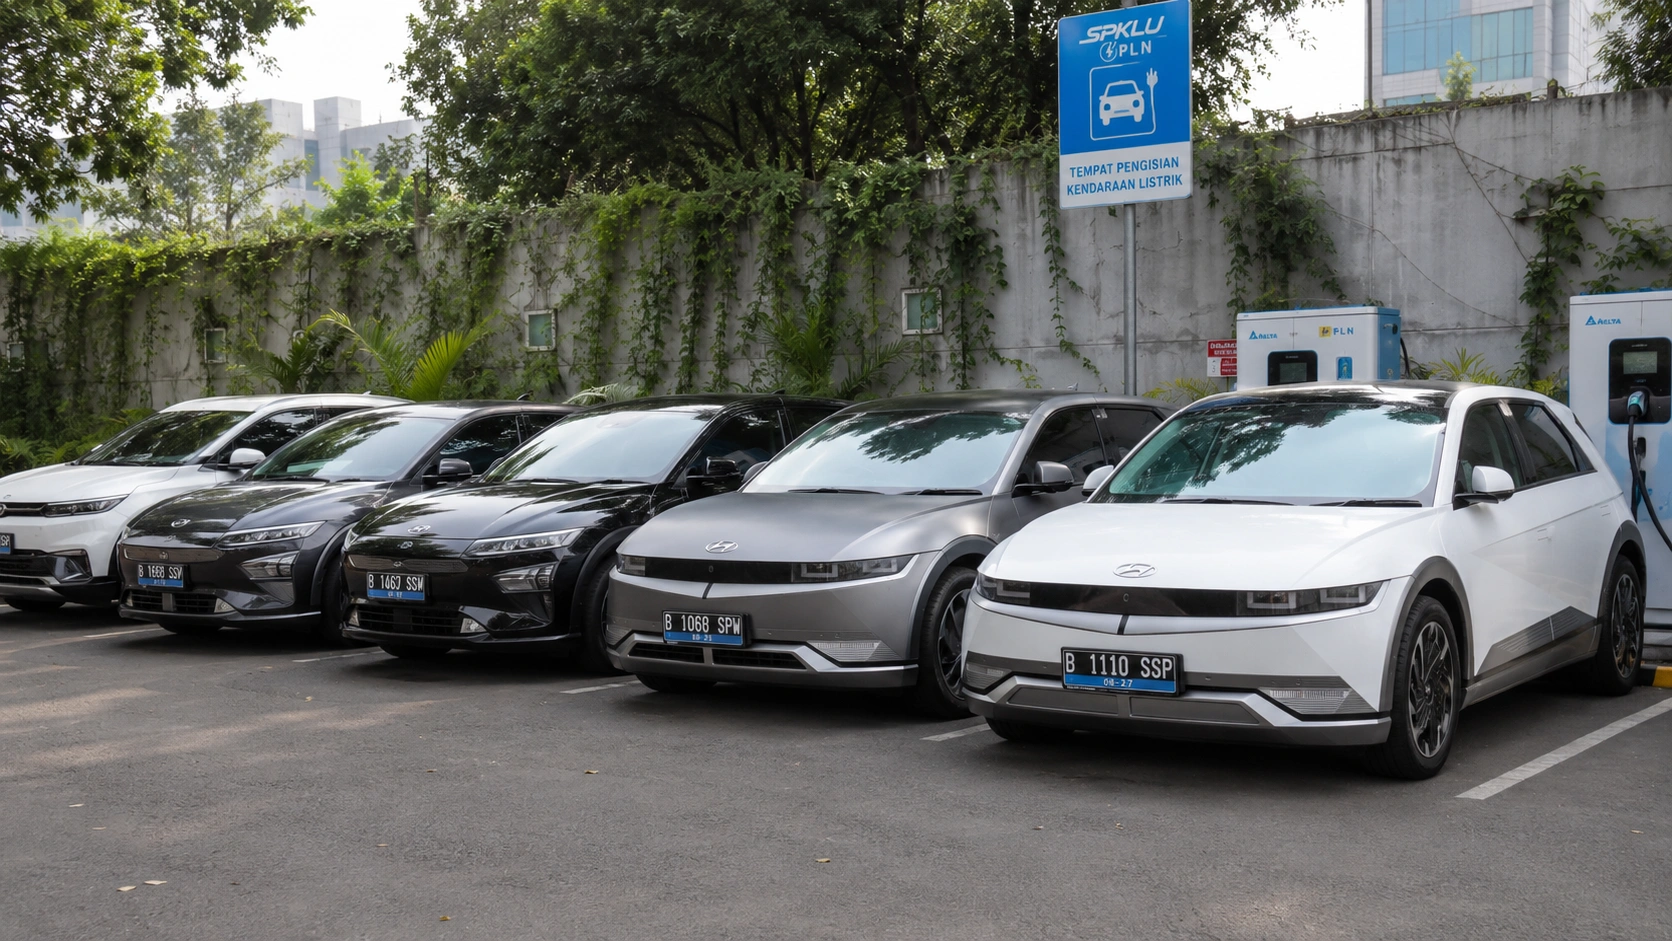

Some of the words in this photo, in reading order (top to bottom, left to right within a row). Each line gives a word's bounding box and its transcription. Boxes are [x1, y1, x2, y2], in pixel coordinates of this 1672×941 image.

[1079, 16, 1165, 45] SPKLU
[1119, 41, 1152, 57] PLN
[1070, 163, 1113, 178] TEMPAT
[1116, 157, 1179, 174] PENGISIAN
[1067, 179, 1135, 196] KENDARAAN
[1139, 174, 1183, 189] LISTRIK
[1333, 327, 1354, 336] PLN
[138, 565, 144, 578] B
[368, 574, 374, 589] B
[665, 614, 672, 631] B
[681, 615, 709, 633] 1068
[718, 617, 740, 635] SPW
[1065, 652, 1075, 673] B
[1090, 654, 1129, 677] 1110
[1140, 657, 1173, 679] SSP
